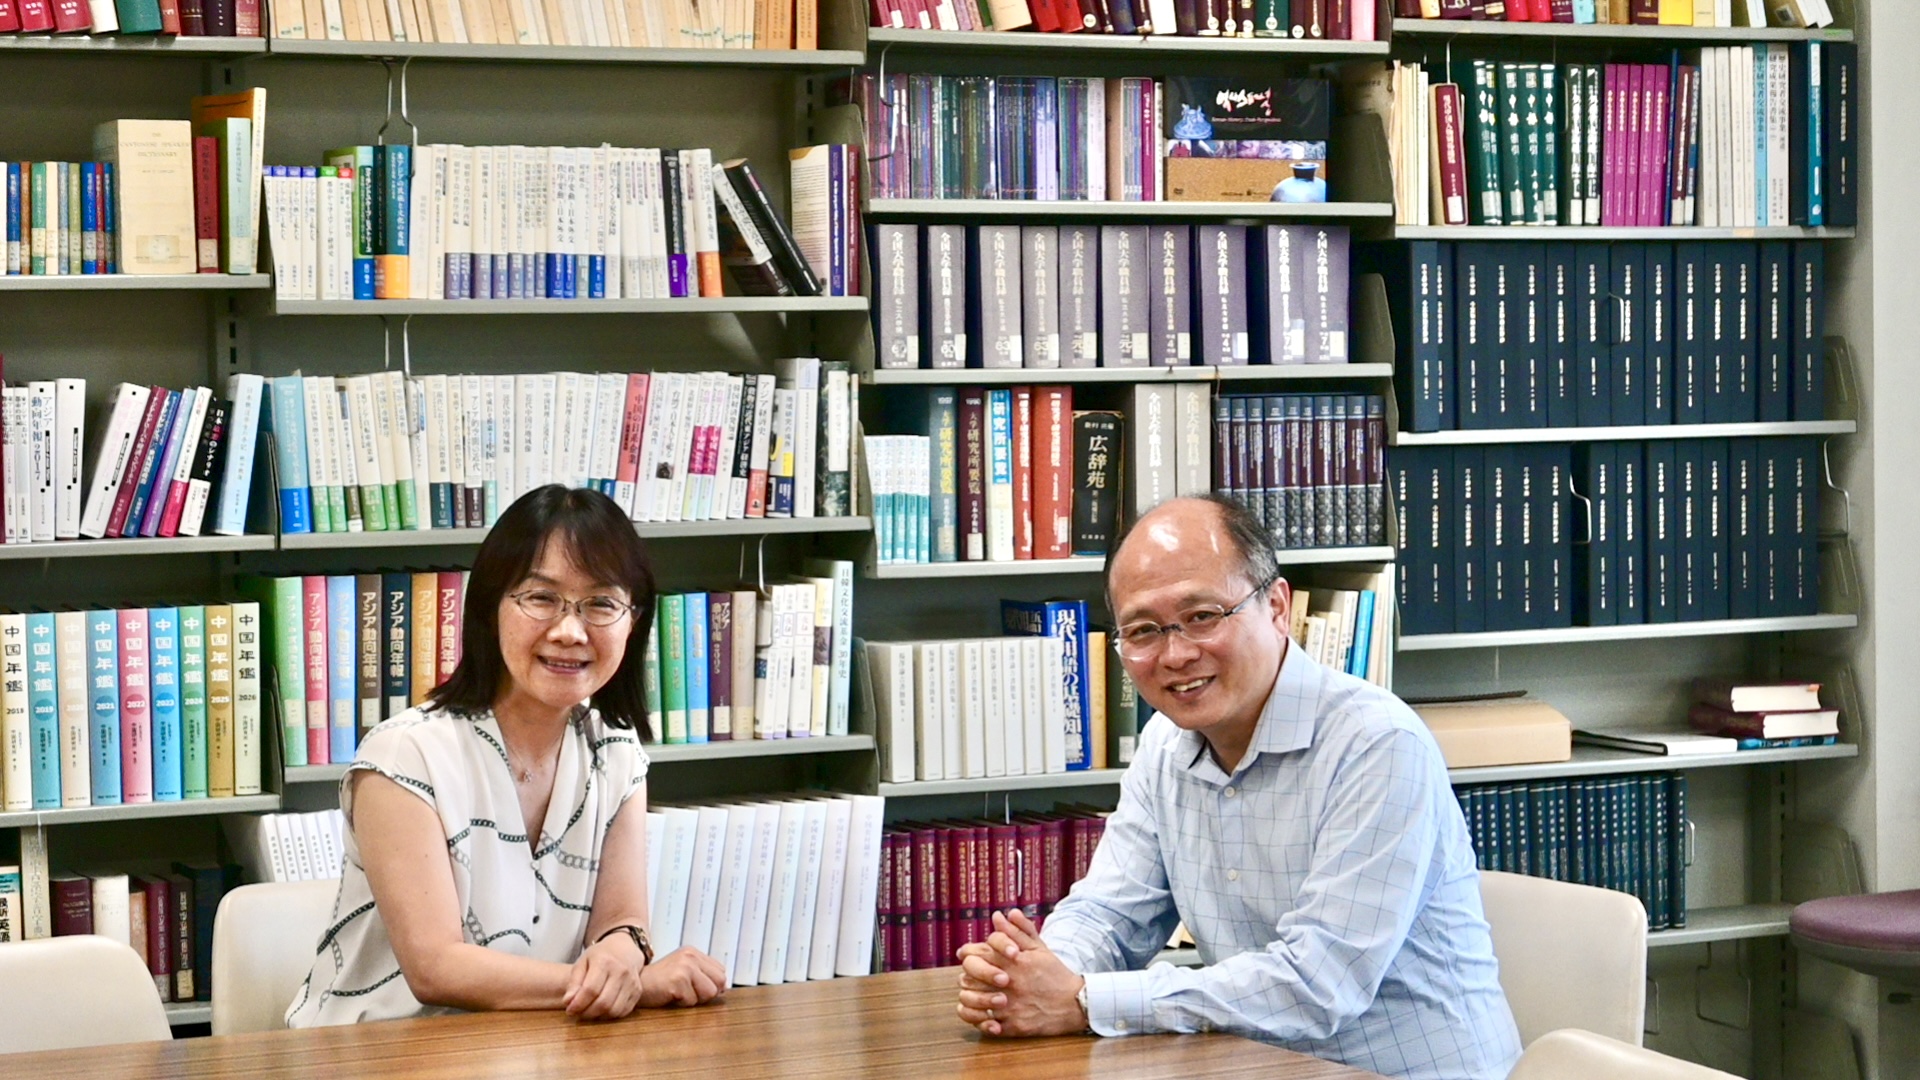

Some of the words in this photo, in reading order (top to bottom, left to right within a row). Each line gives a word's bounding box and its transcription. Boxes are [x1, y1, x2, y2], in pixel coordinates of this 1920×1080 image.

[43, 396, 53, 427] アジア
[757, 381, 770, 436] アジア経済史
[993, 401, 1008, 476] 研究所要覧
[967, 412, 981, 494] 大学研究所要覧
[1086, 435, 1109, 489] 広辞苑
[309, 592, 323, 681] アジア動向年報
[362, 592, 377, 678] アジア動向年報
[390, 591, 405, 678] アジア動向年報
[840, 568, 850, 646] 日韓文化交流基金
[5, 626, 23, 692] 中国年鑑
[33, 624, 53, 692] 中国年鑑
[95, 621, 115, 688] 中国年鑑
[126, 619, 146, 686] 中国年鑑
[155, 618, 175, 686] 中国年鑑
[183, 616, 203, 684] 中国年鑑
[210, 615, 229, 682] 中国年鑑
[238, 613, 256, 679] 中国年鑑
[6, 707, 24, 715] 2018
[96, 702, 115, 710] 2021
[127, 700, 146, 709] 2022
